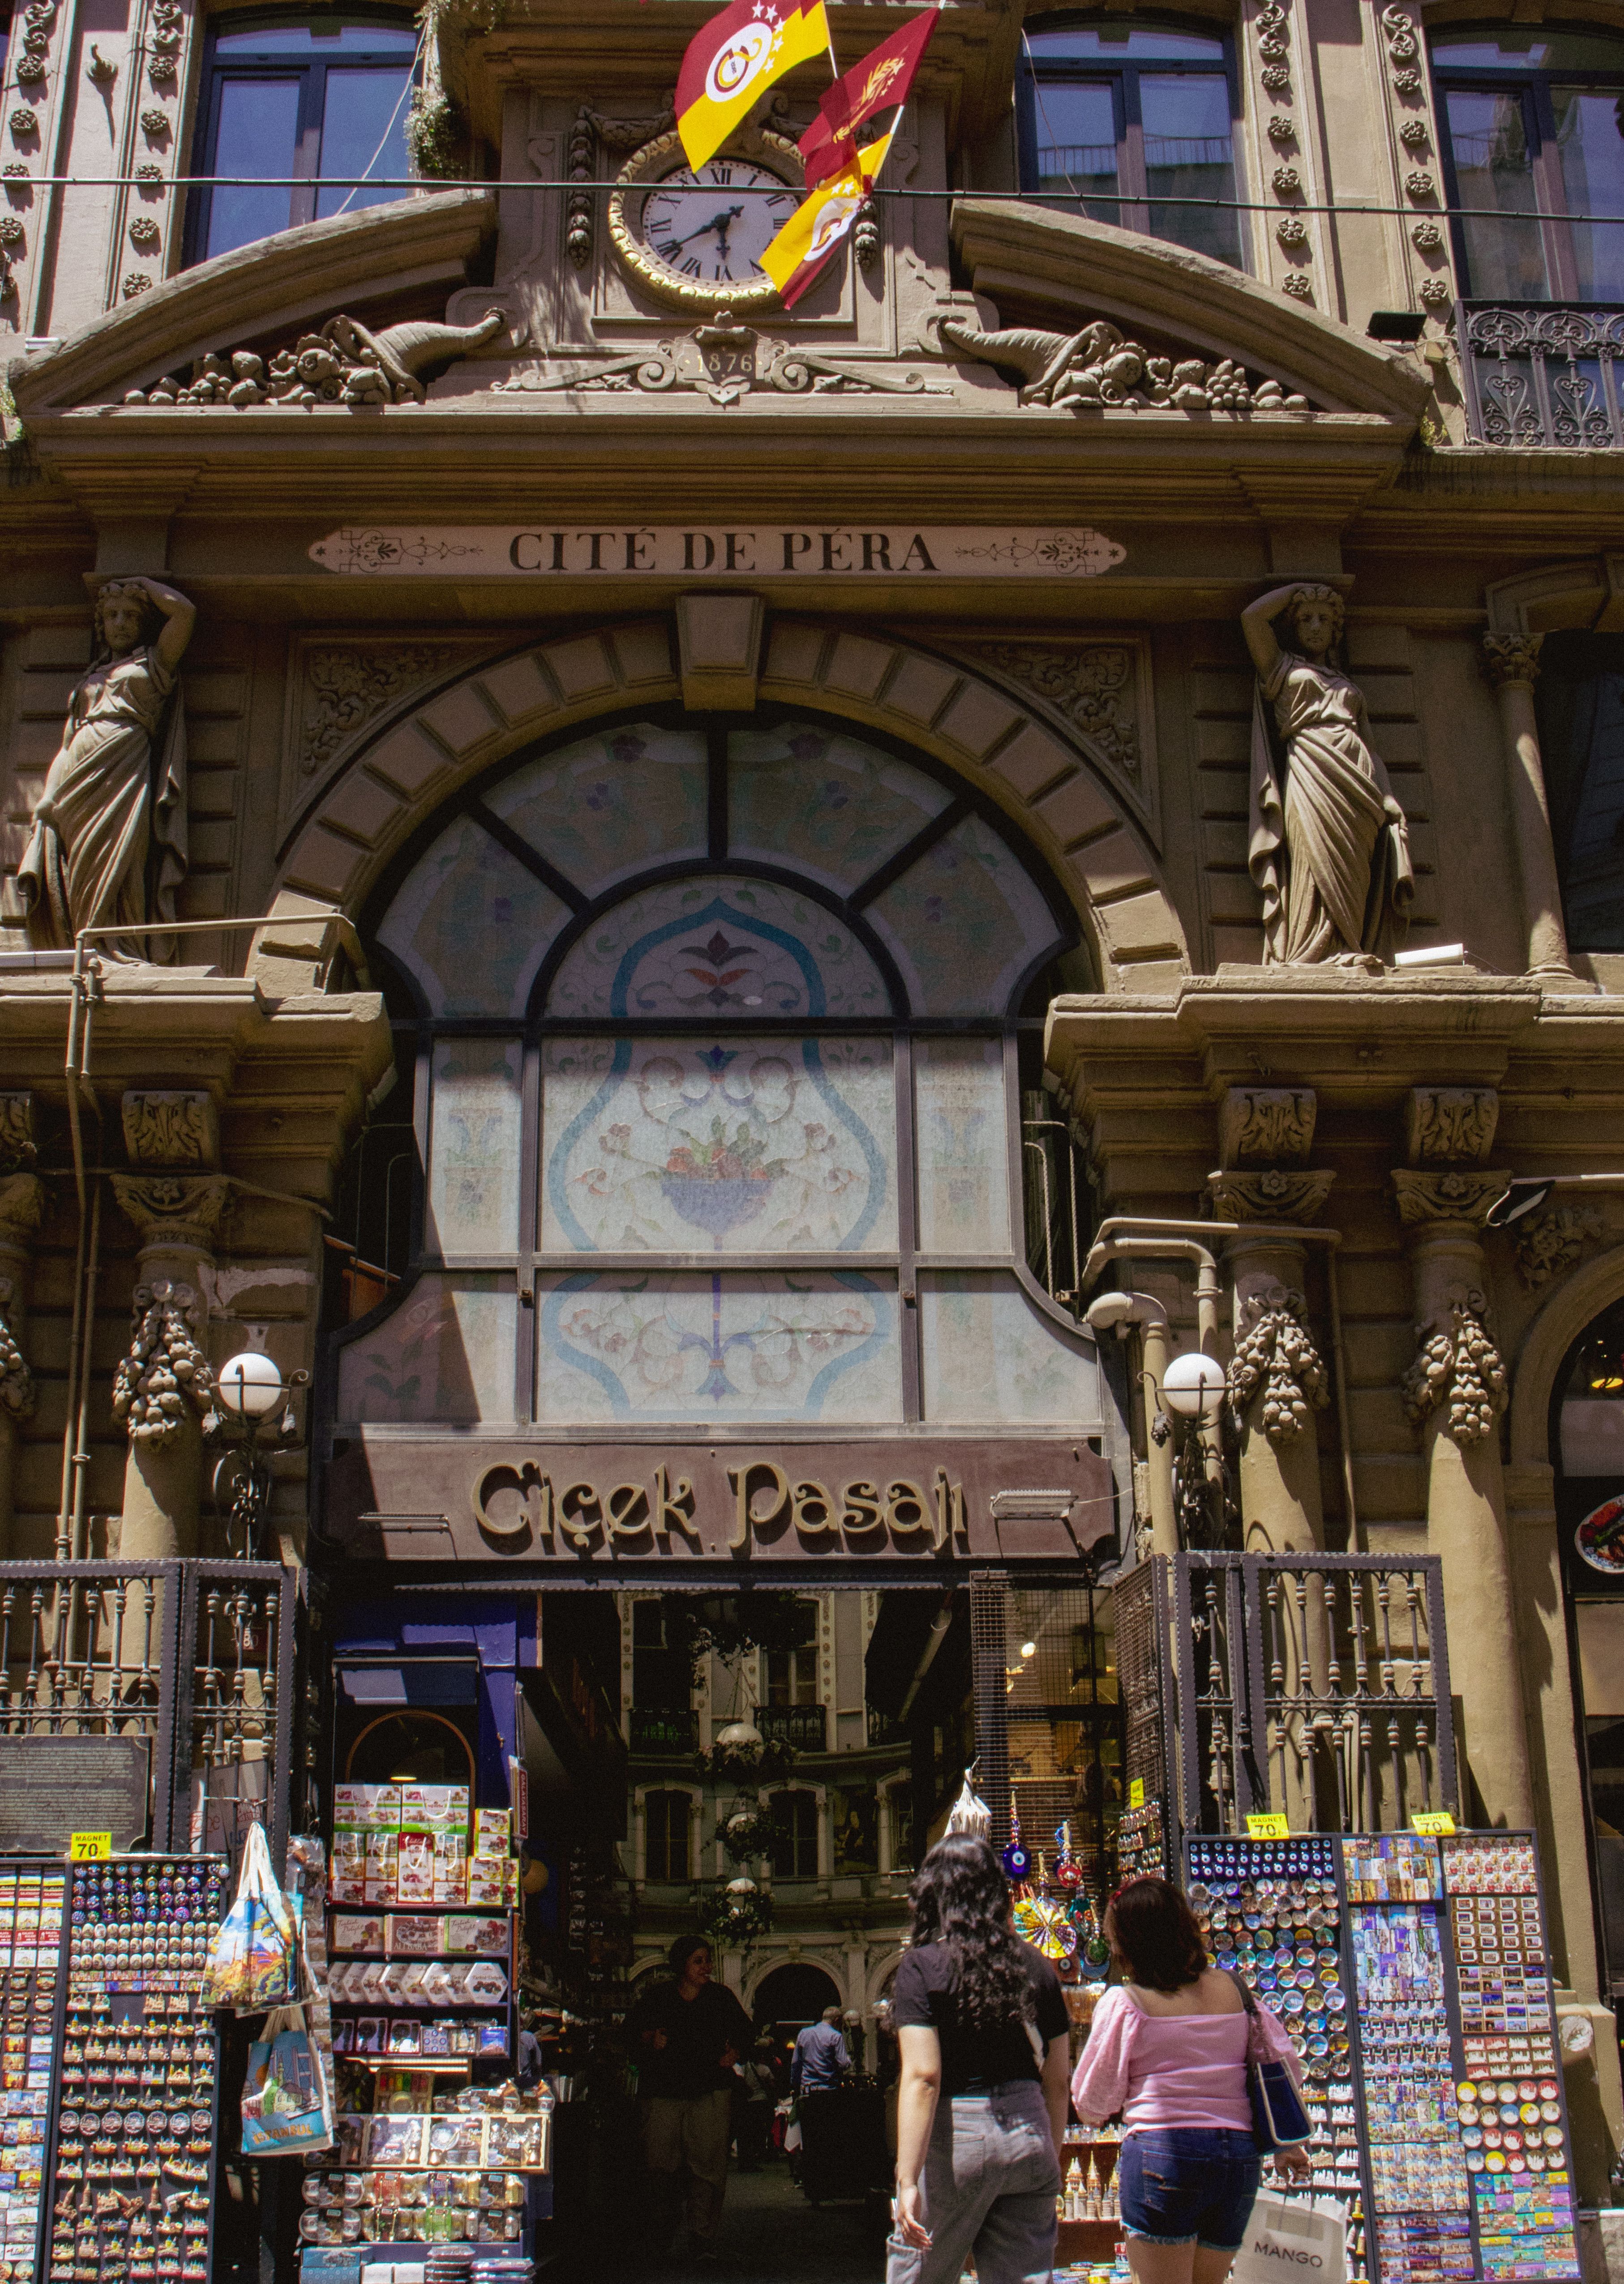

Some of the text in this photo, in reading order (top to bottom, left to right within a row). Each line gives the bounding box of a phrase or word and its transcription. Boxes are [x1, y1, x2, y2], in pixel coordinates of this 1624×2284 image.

[510, 527, 941, 571] CITÉ DE PÉRA
[1254, 2241, 1323, 2268] MANGO
